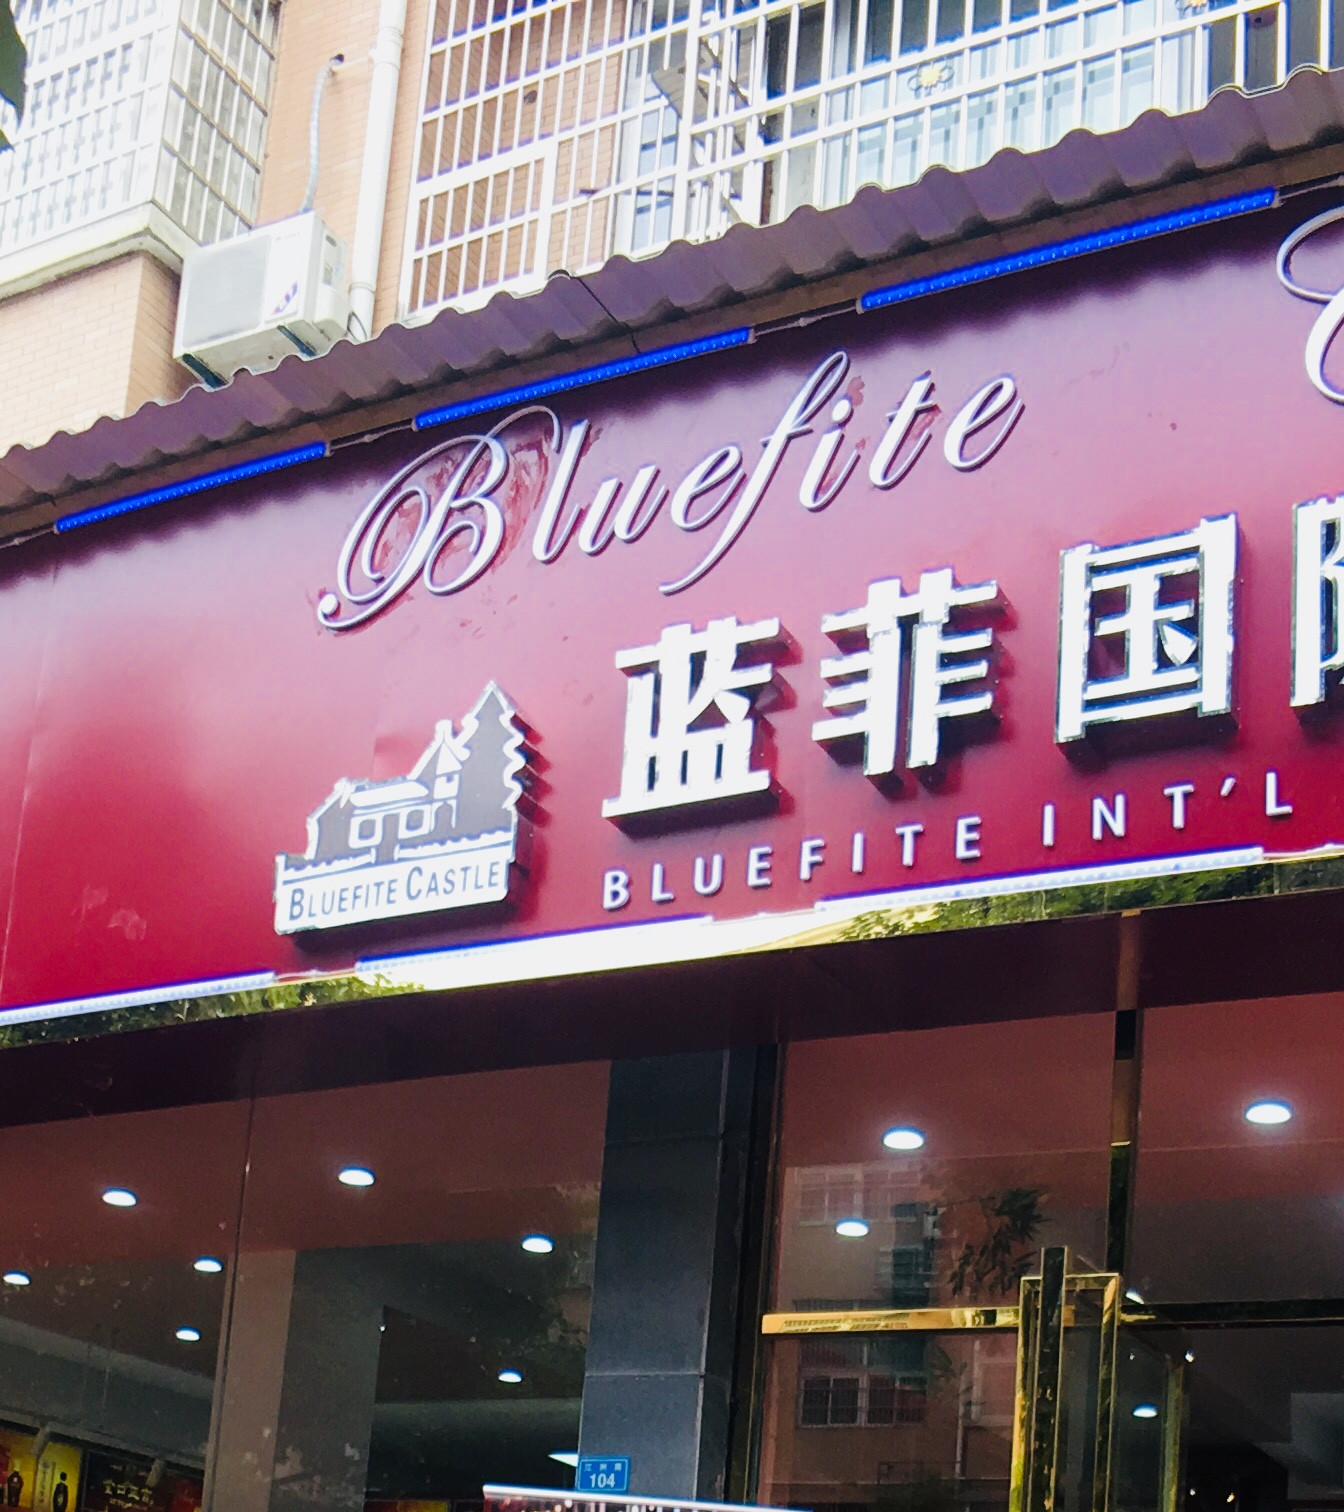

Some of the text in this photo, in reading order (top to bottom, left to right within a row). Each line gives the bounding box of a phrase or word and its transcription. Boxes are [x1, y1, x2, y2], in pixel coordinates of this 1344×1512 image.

[318, 349, 1025, 630] Bluefite
[289, 862, 501, 921] BLUEFITE CASTLE
[603, 816, 982, 911] BLUEFITE
[589, 1472, 616, 1489] 104
